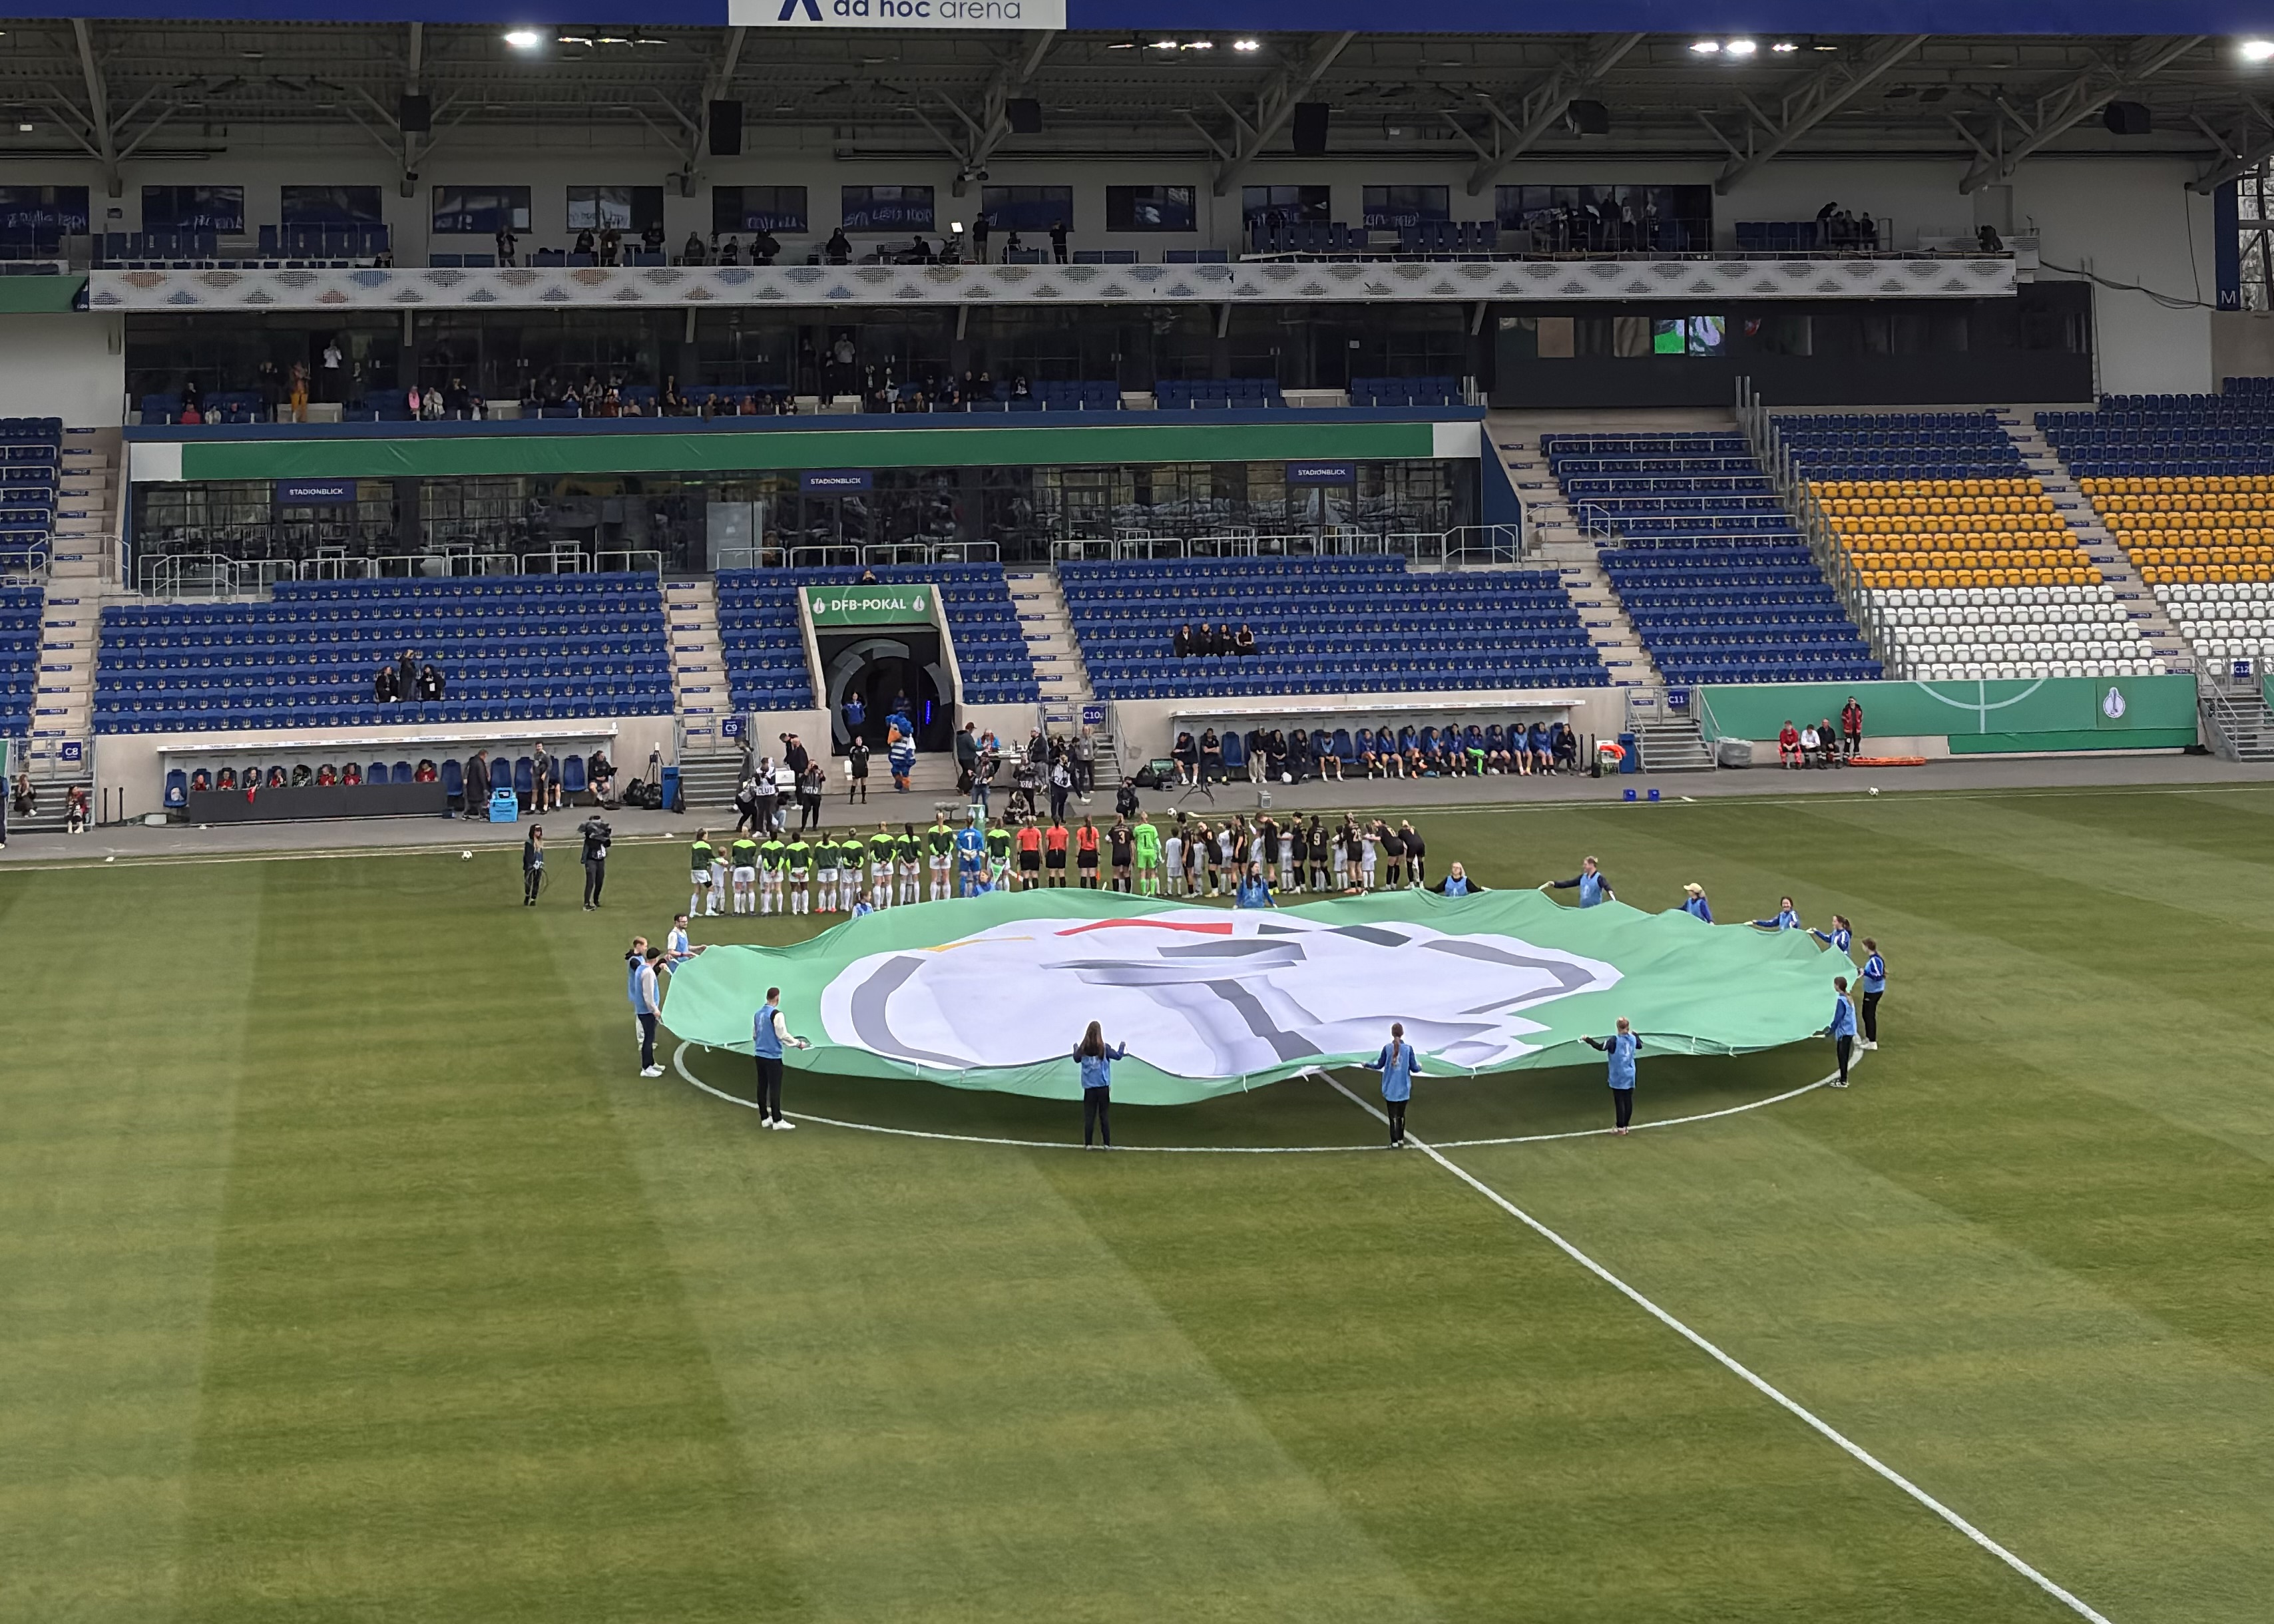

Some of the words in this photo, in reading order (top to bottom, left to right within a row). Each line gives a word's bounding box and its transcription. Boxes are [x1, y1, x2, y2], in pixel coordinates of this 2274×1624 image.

[833, 0, 869, 17] ad
[880, 0, 931, 17] hoc
[939, 1, 1021, 19] arena
[2221, 290, 2235, 304] M
[831, 598, 906, 611] DFB-POKAL
[1668, 696, 1685, 704] C11
[1083, 711, 1100, 719] C10
[725, 723, 738, 732] C9
[65, 747, 79, 756] C8
[967, 836, 973, 849] 1
[1118, 831, 1126, 844] 3
[1313, 833, 1321, 846] 9
